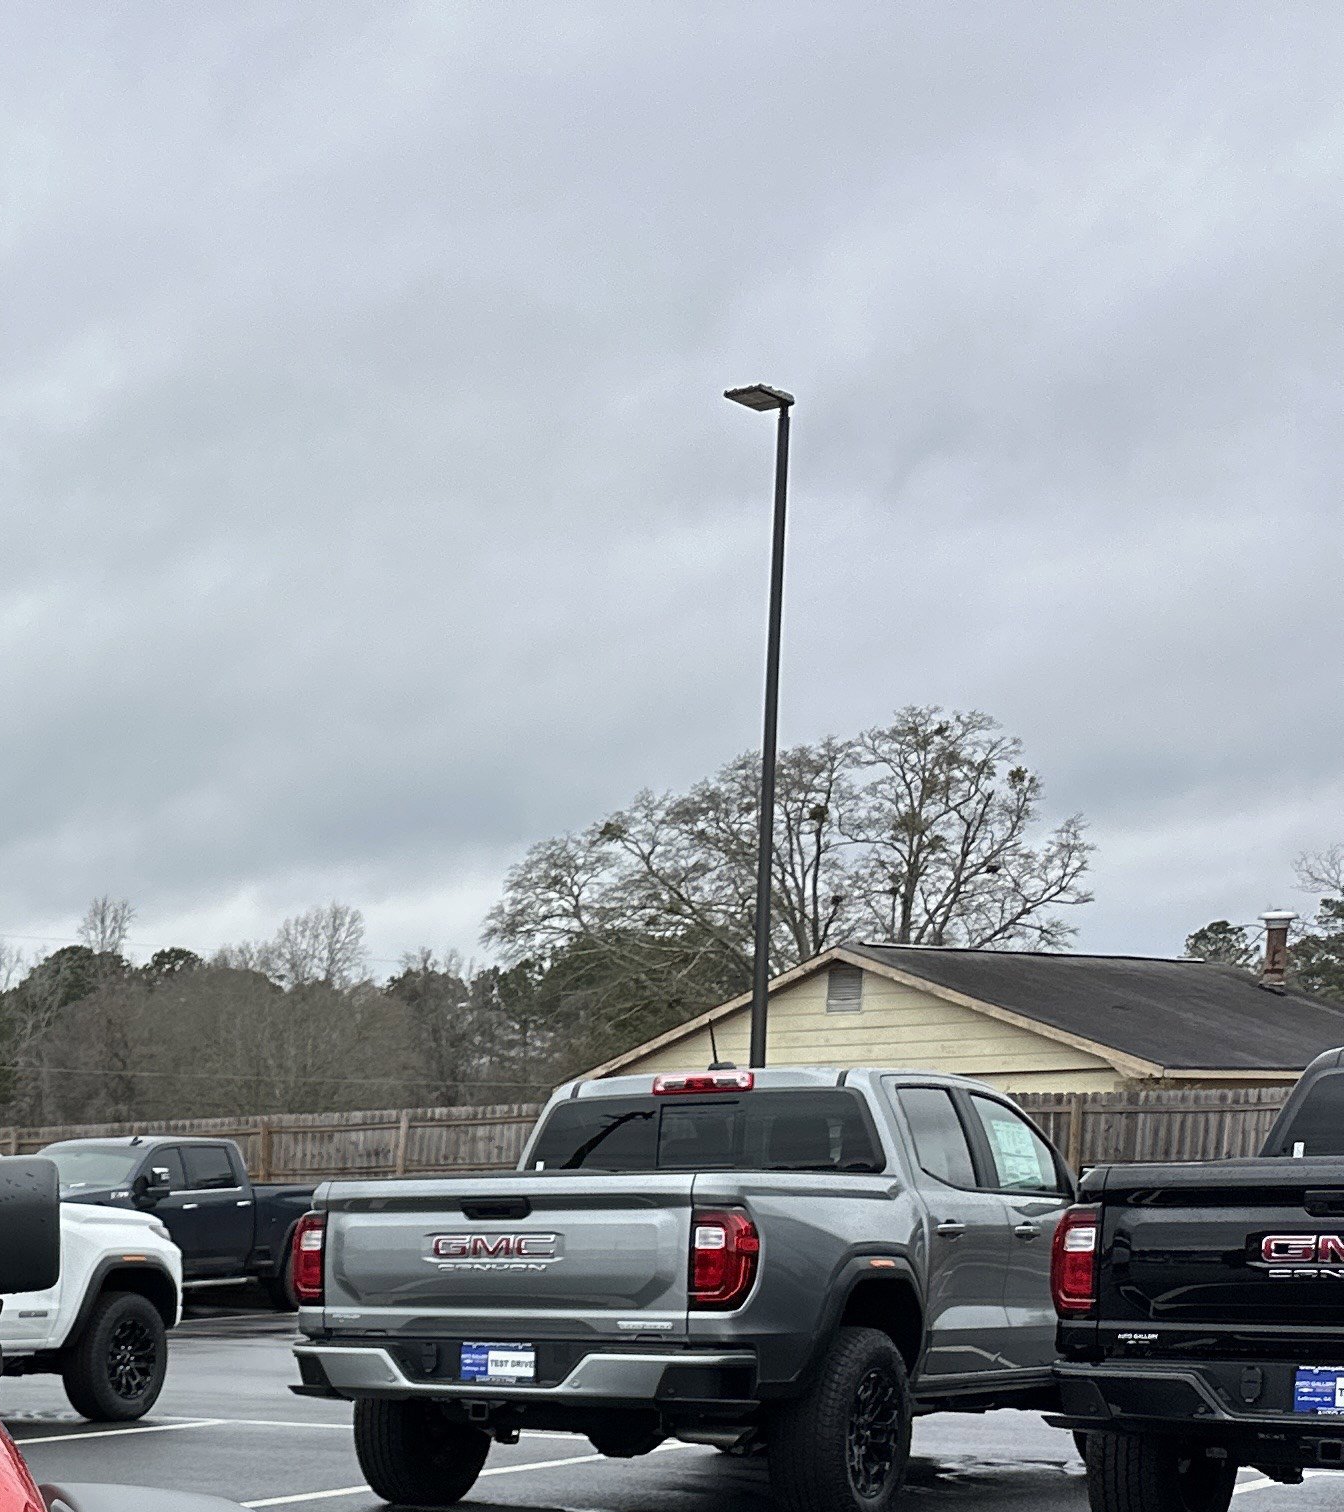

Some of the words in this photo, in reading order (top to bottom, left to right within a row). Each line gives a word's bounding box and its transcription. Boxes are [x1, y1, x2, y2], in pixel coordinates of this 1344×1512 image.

[432, 1234, 556, 1257] GMC
[437, 1264, 547, 1272] CANYON
[490, 1359, 509, 1368] TEST
